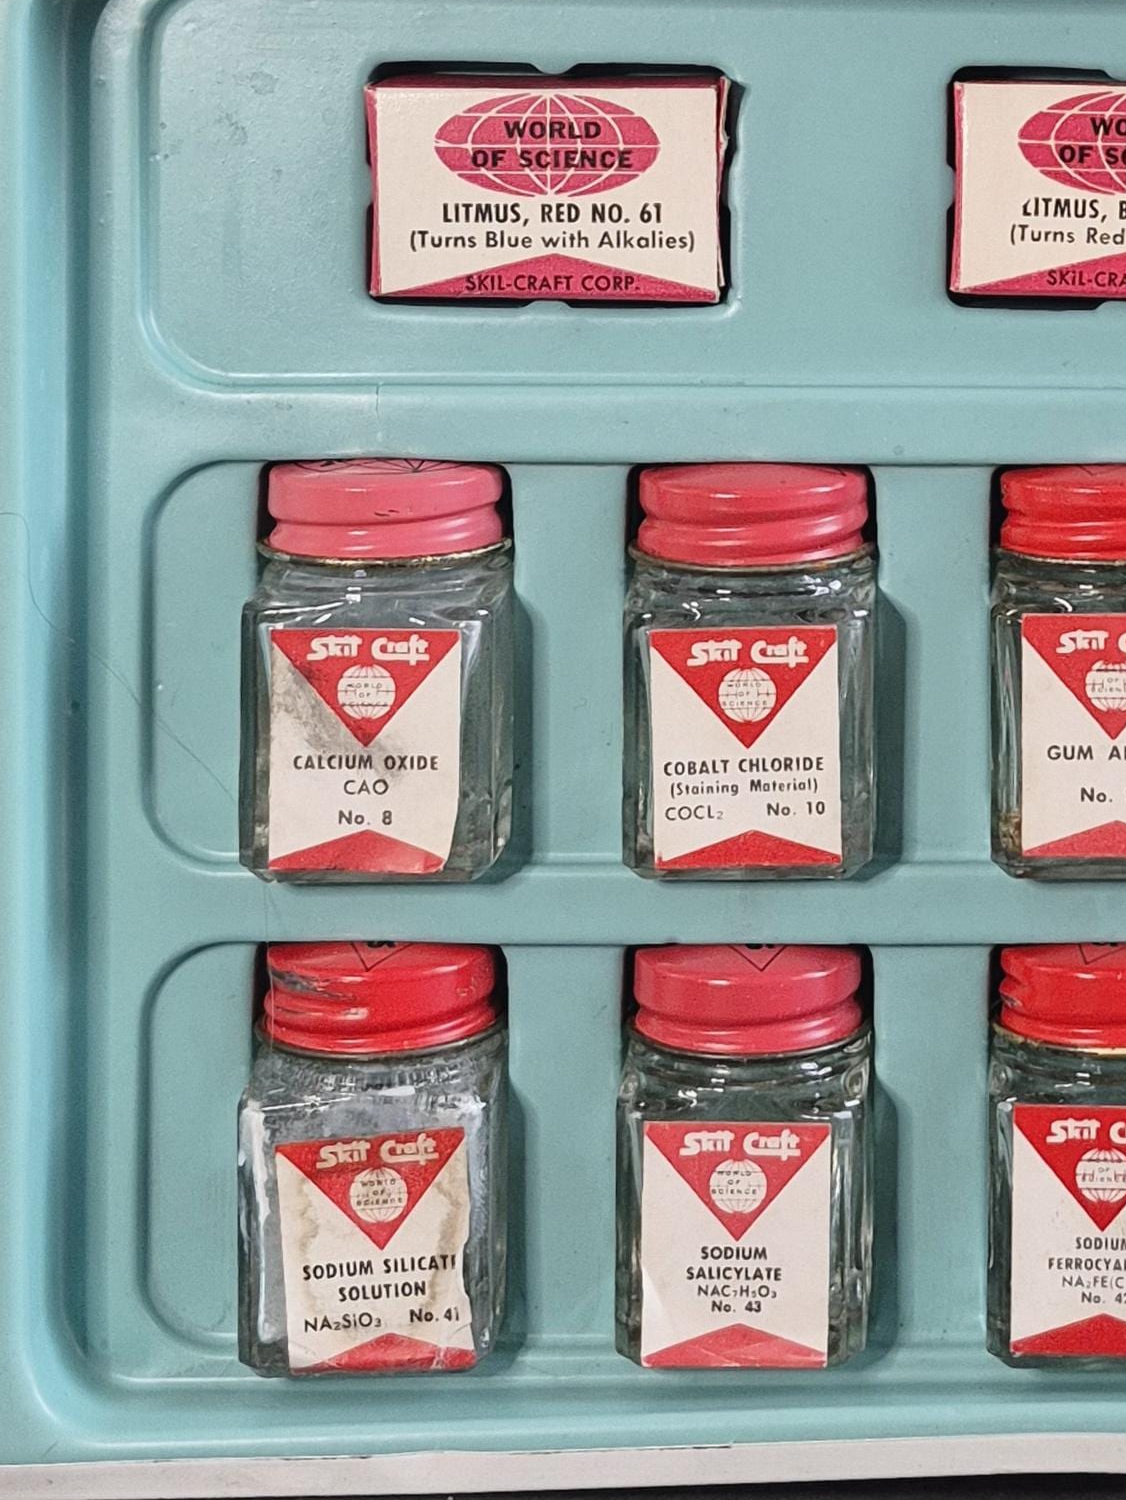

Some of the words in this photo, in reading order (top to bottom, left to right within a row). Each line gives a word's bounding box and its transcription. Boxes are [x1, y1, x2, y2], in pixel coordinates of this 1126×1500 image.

[504, 120, 601, 139] WORLD
[471, 150, 505, 168] OF
[519, 150, 633, 169] SCIENCE
[1058, 145, 1092, 164] OF
[442, 203, 530, 227] LITMUS,
[541, 203, 580, 224] RED
[591, 203, 631, 224] NO.
[639, 203, 663, 224] 61
[1022, 197, 1108, 222] LITMUS,
[409, 230, 477, 252] (Turns
[486, 230, 533, 249] Blue
[541, 230, 590, 249] with
[598, 230, 696, 252] Alkalies)
[1010, 224, 1076, 246] (Turns
[1087, 227, 1126, 246] Red
[465, 274, 572, 292] SKIL-CRAFT
[582, 275, 641, 292] CORP.
[371, 634, 430, 665] Craft
[751, 636, 810, 668] Craft
[293, 754, 373, 770] CALCIUM
[384, 755, 439, 771] OXIDE
[1047, 745, 1093, 761] GUM
[663, 759, 730, 776] COBALT
[738, 756, 824, 773] CHLORIDE
[343, 778, 389, 795] CAO
[670, 780, 739, 799] (Staining
[750, 778, 819, 794] Material)
[1080, 787, 1112, 803] No.
[338, 810, 371, 826] No.
[382, 810, 393, 826] 8
[767, 803, 797, 817] No.
[806, 801, 826, 816] 10
[380, 1133, 439, 1165] Craft
[743, 1129, 801, 1161] Craft
[701, 1246, 767, 1260] SODIUM
[303, 1259, 374, 1281] SODIUM
[686, 1267, 782, 1281] SALICYLATE
[338, 1280, 426, 1302] SOLUTION
[1081, 1291, 1106, 1304] No.
[409, 1307, 440, 1323] No.
[711, 1300, 737, 1313] No.
[744, 1300, 762, 1313] 43
